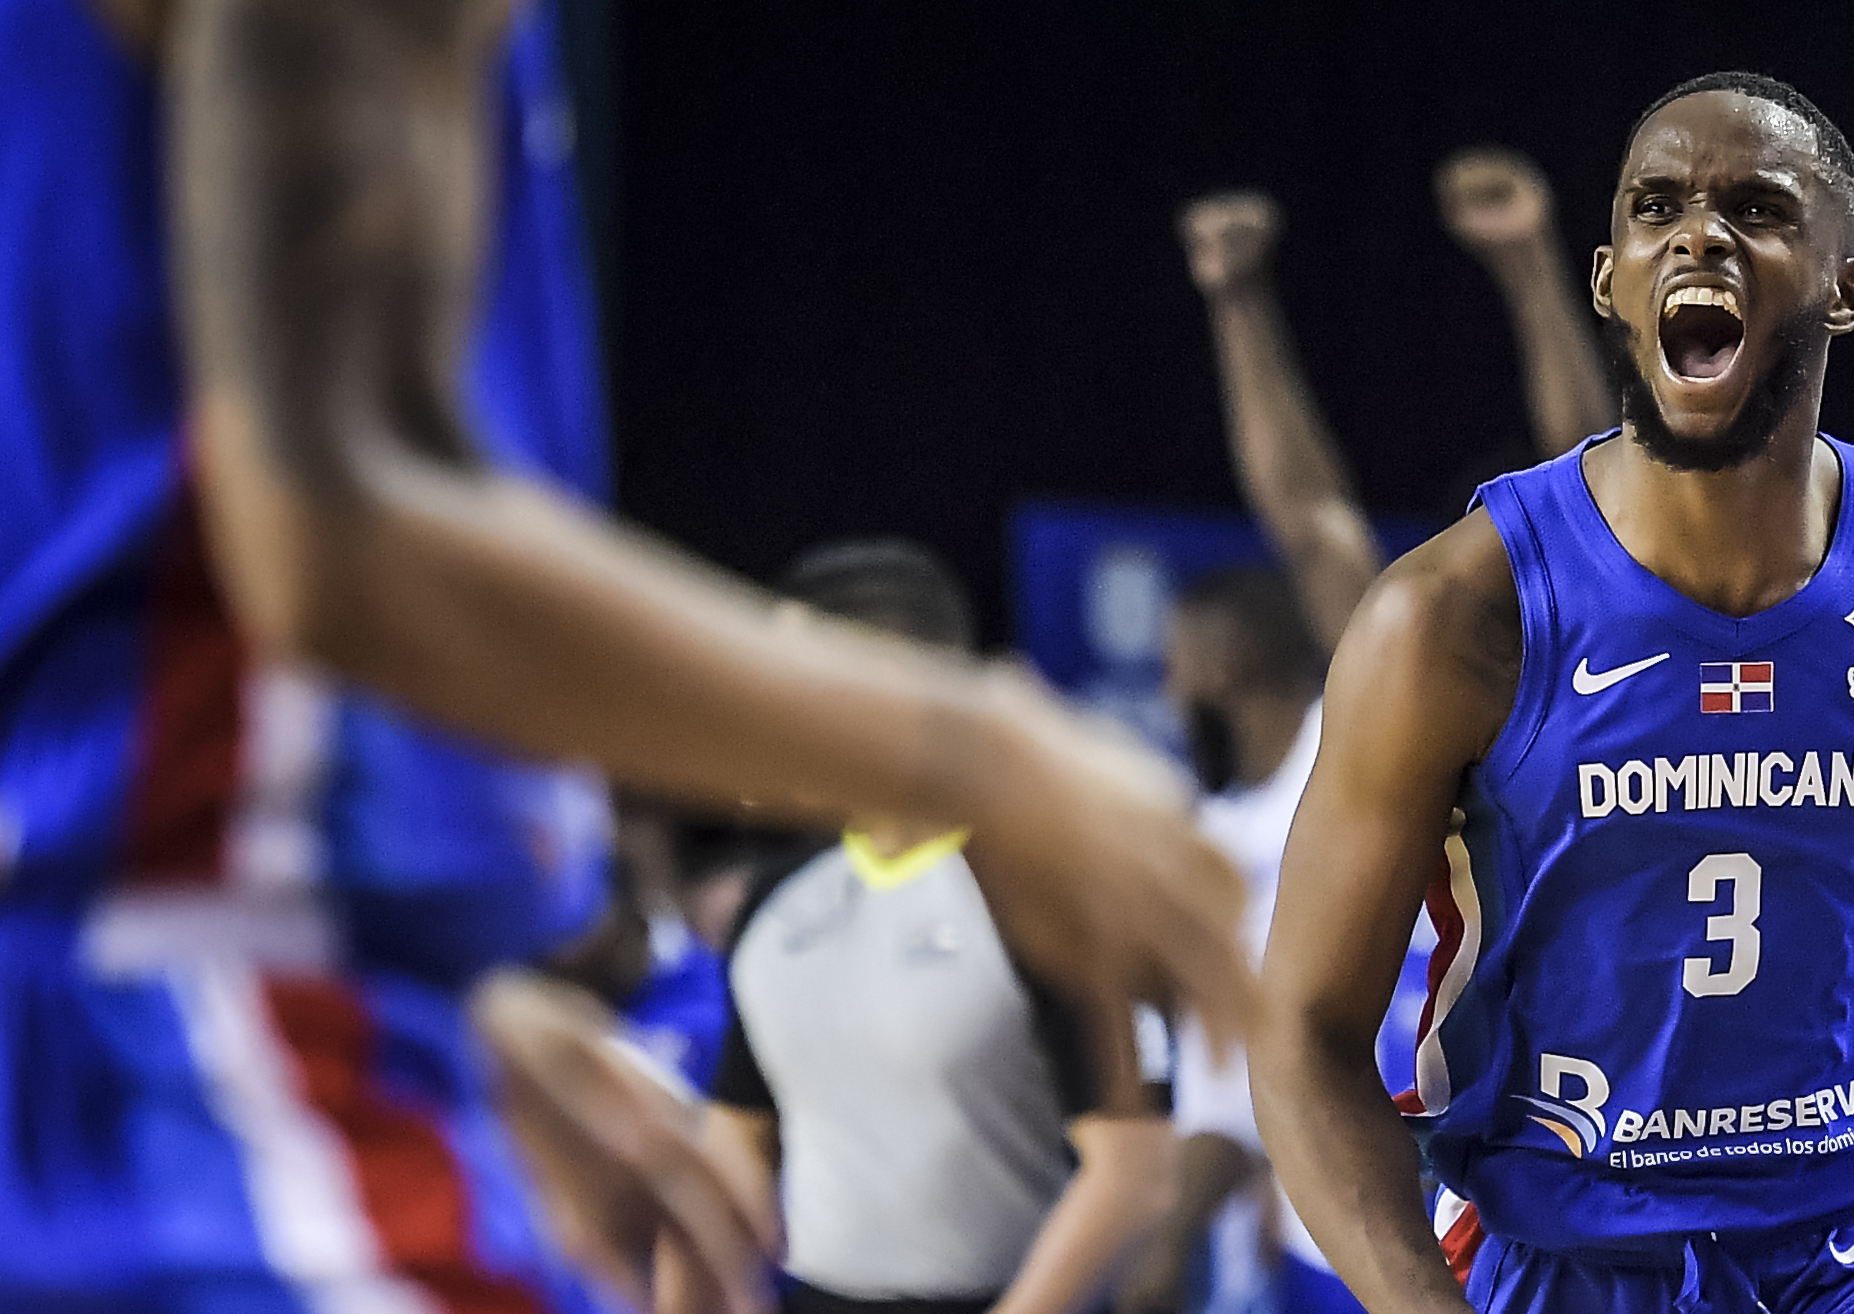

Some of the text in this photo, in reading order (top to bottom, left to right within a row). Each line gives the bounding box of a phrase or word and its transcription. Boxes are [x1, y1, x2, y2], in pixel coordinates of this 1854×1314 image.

[1682, 853, 1762, 998] 3
[1609, 1151, 1627, 1169] El
[1632, 1149, 1692, 1168] banco
[1697, 1145, 1722, 1158] de
[1725, 1141, 1783, 1156] todos
[1786, 1138, 1814, 1155] los
